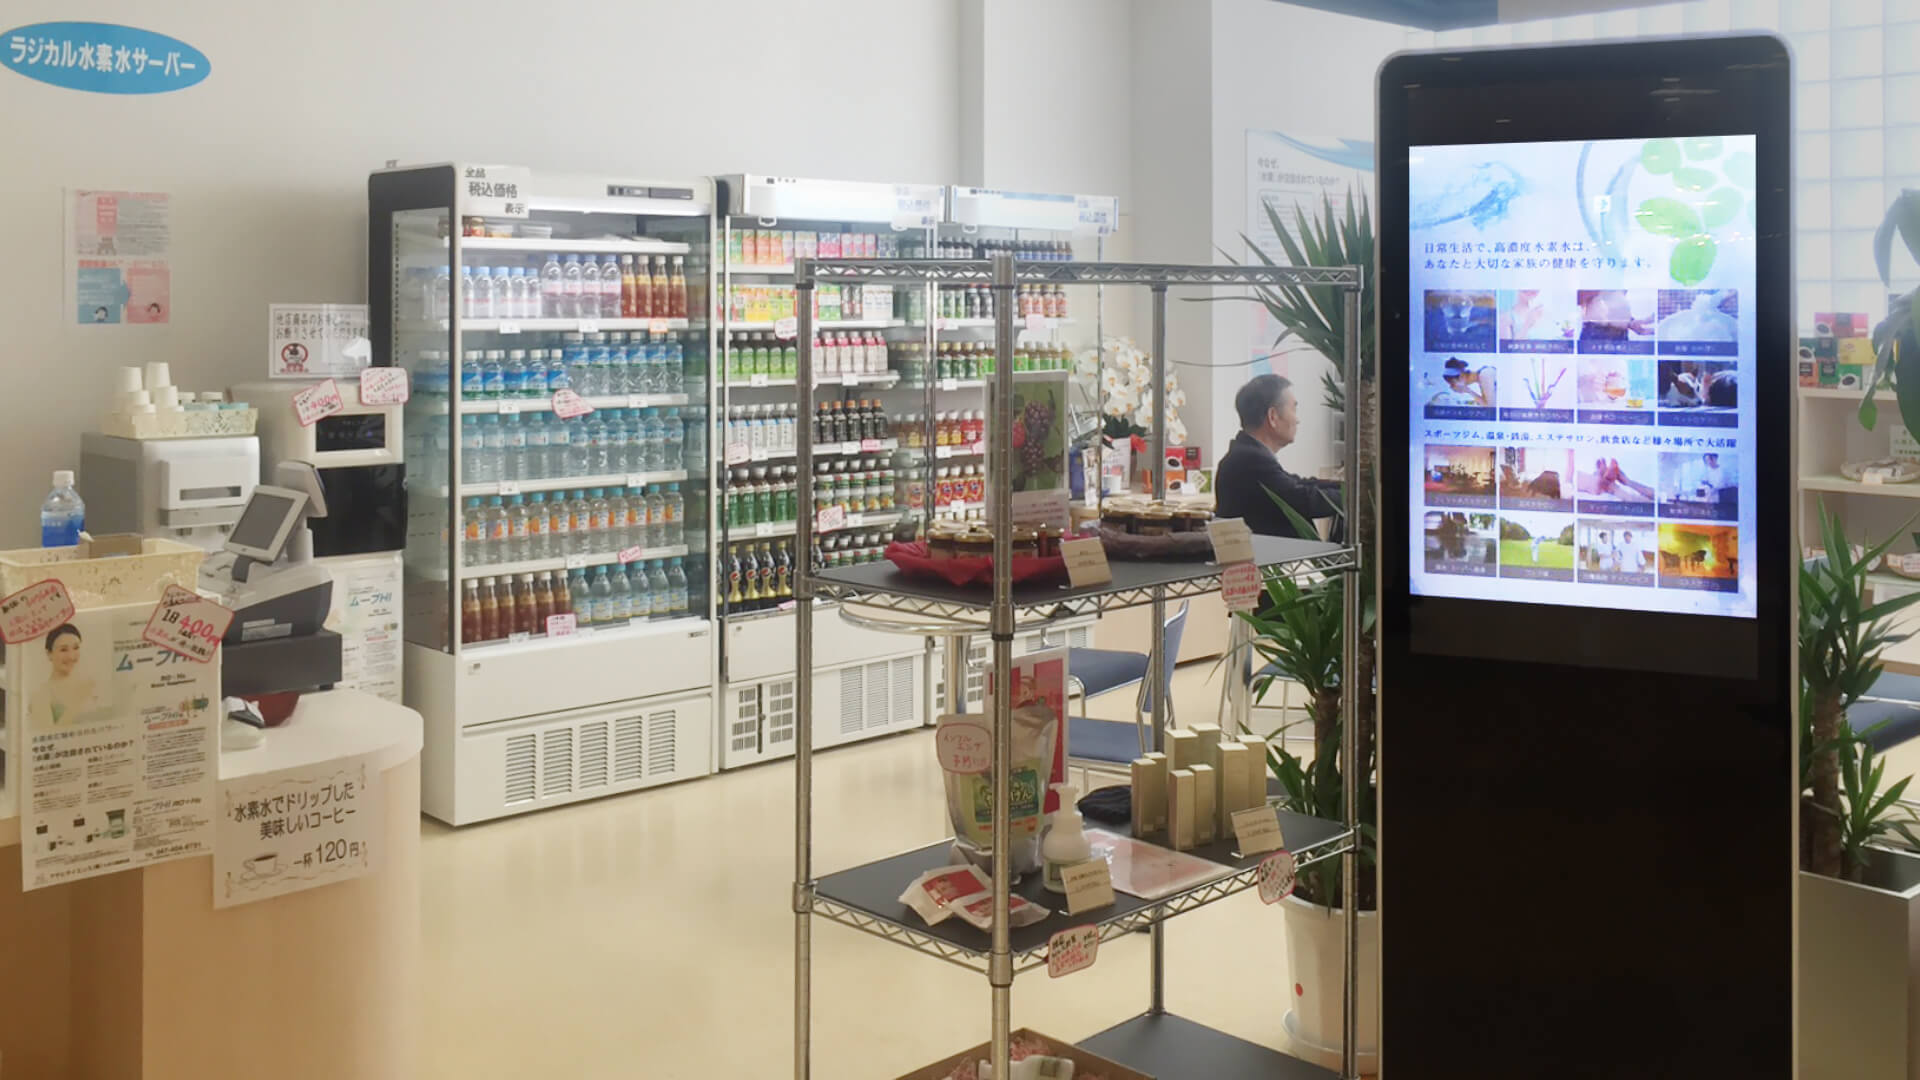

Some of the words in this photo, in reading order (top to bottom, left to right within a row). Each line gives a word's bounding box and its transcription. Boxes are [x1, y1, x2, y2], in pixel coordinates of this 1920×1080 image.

[10, 35, 196, 77] ラジカル水素水サーバー
[465, 167, 486, 178] 全品
[468, 181, 518, 199] 税込価格
[504, 203, 525, 215] 表示
[234, 782, 355, 823] 水素水でドリップした
[260, 807, 357, 840] 美味しいコーヒー
[293, 852, 313, 868] 一杯
[315, 838, 360, 865] 120円
